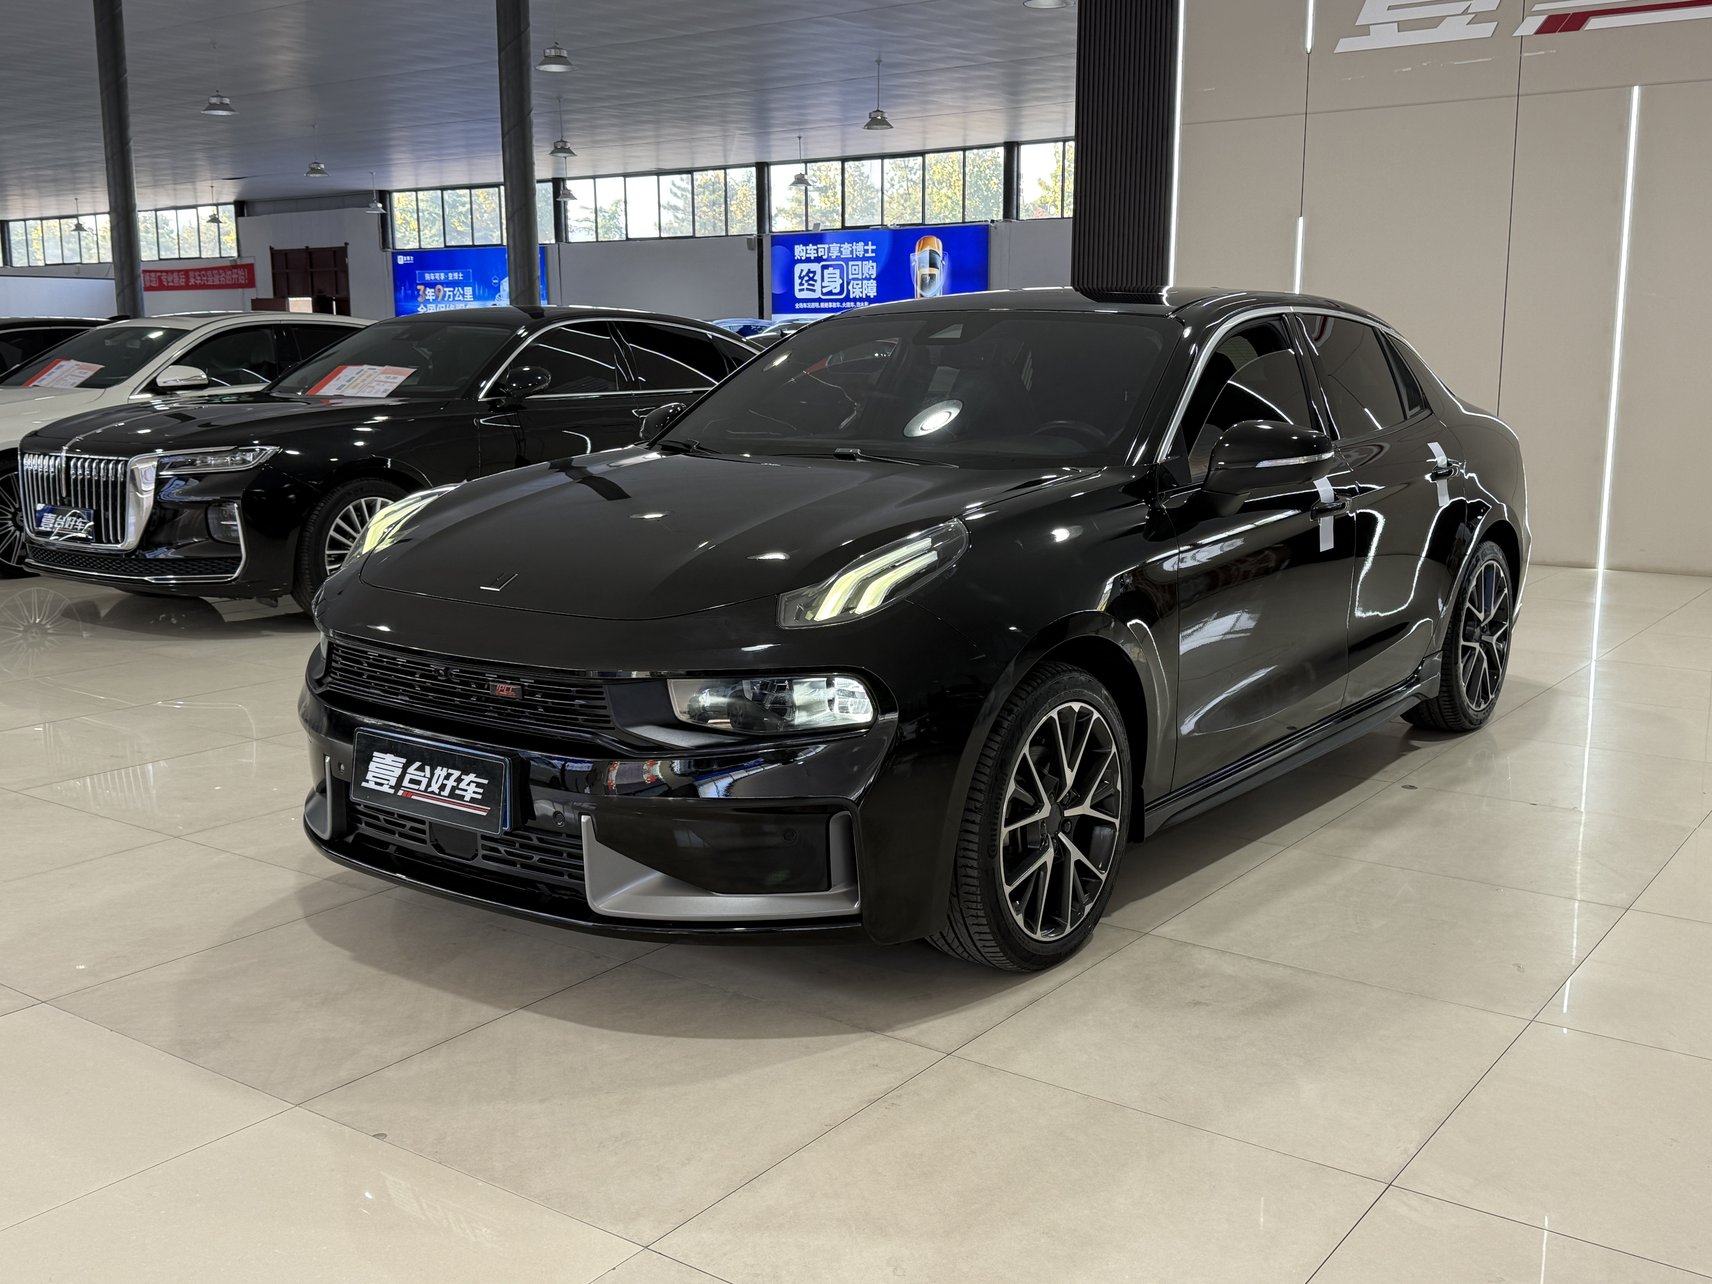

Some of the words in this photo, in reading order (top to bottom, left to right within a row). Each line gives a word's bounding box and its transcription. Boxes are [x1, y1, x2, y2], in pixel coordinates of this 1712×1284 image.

[794, 241, 876, 260] 购车可享查博士
[848, 261, 877, 280] 回购
[796, 266, 844, 295] 终身
[848, 280, 877, 299] 保障
[416, 284, 474, 303] 3年9万公里
[38, 512, 87, 532] 壹台好车
[361, 751, 489, 802] 壹台好车
